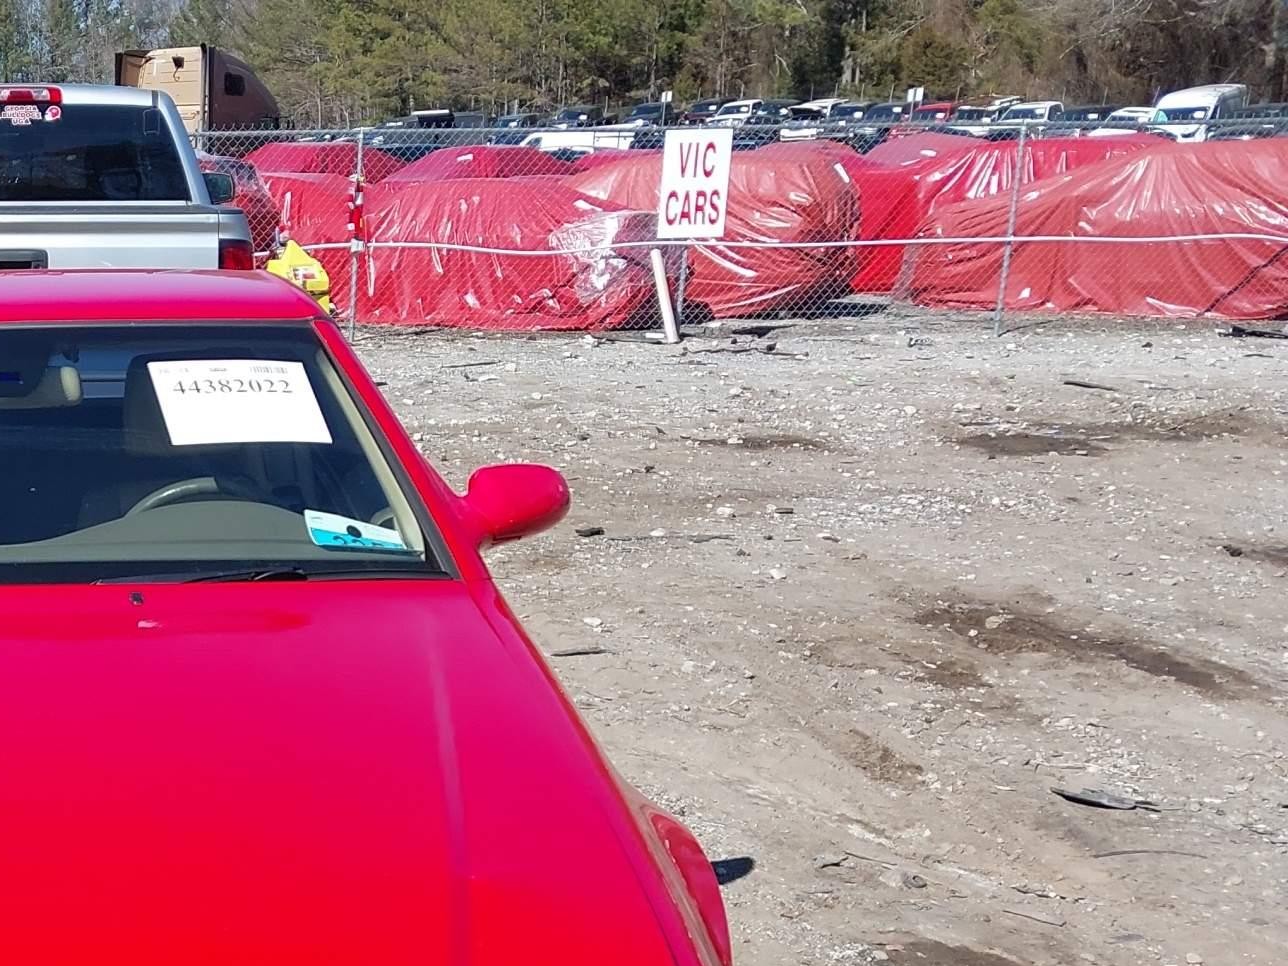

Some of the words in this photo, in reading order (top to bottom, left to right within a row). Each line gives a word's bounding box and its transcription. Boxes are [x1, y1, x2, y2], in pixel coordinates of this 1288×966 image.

[679, 141, 717, 178] VIC
[665, 189, 721, 226] CARS
[173, 378, 293, 395] 44382022
